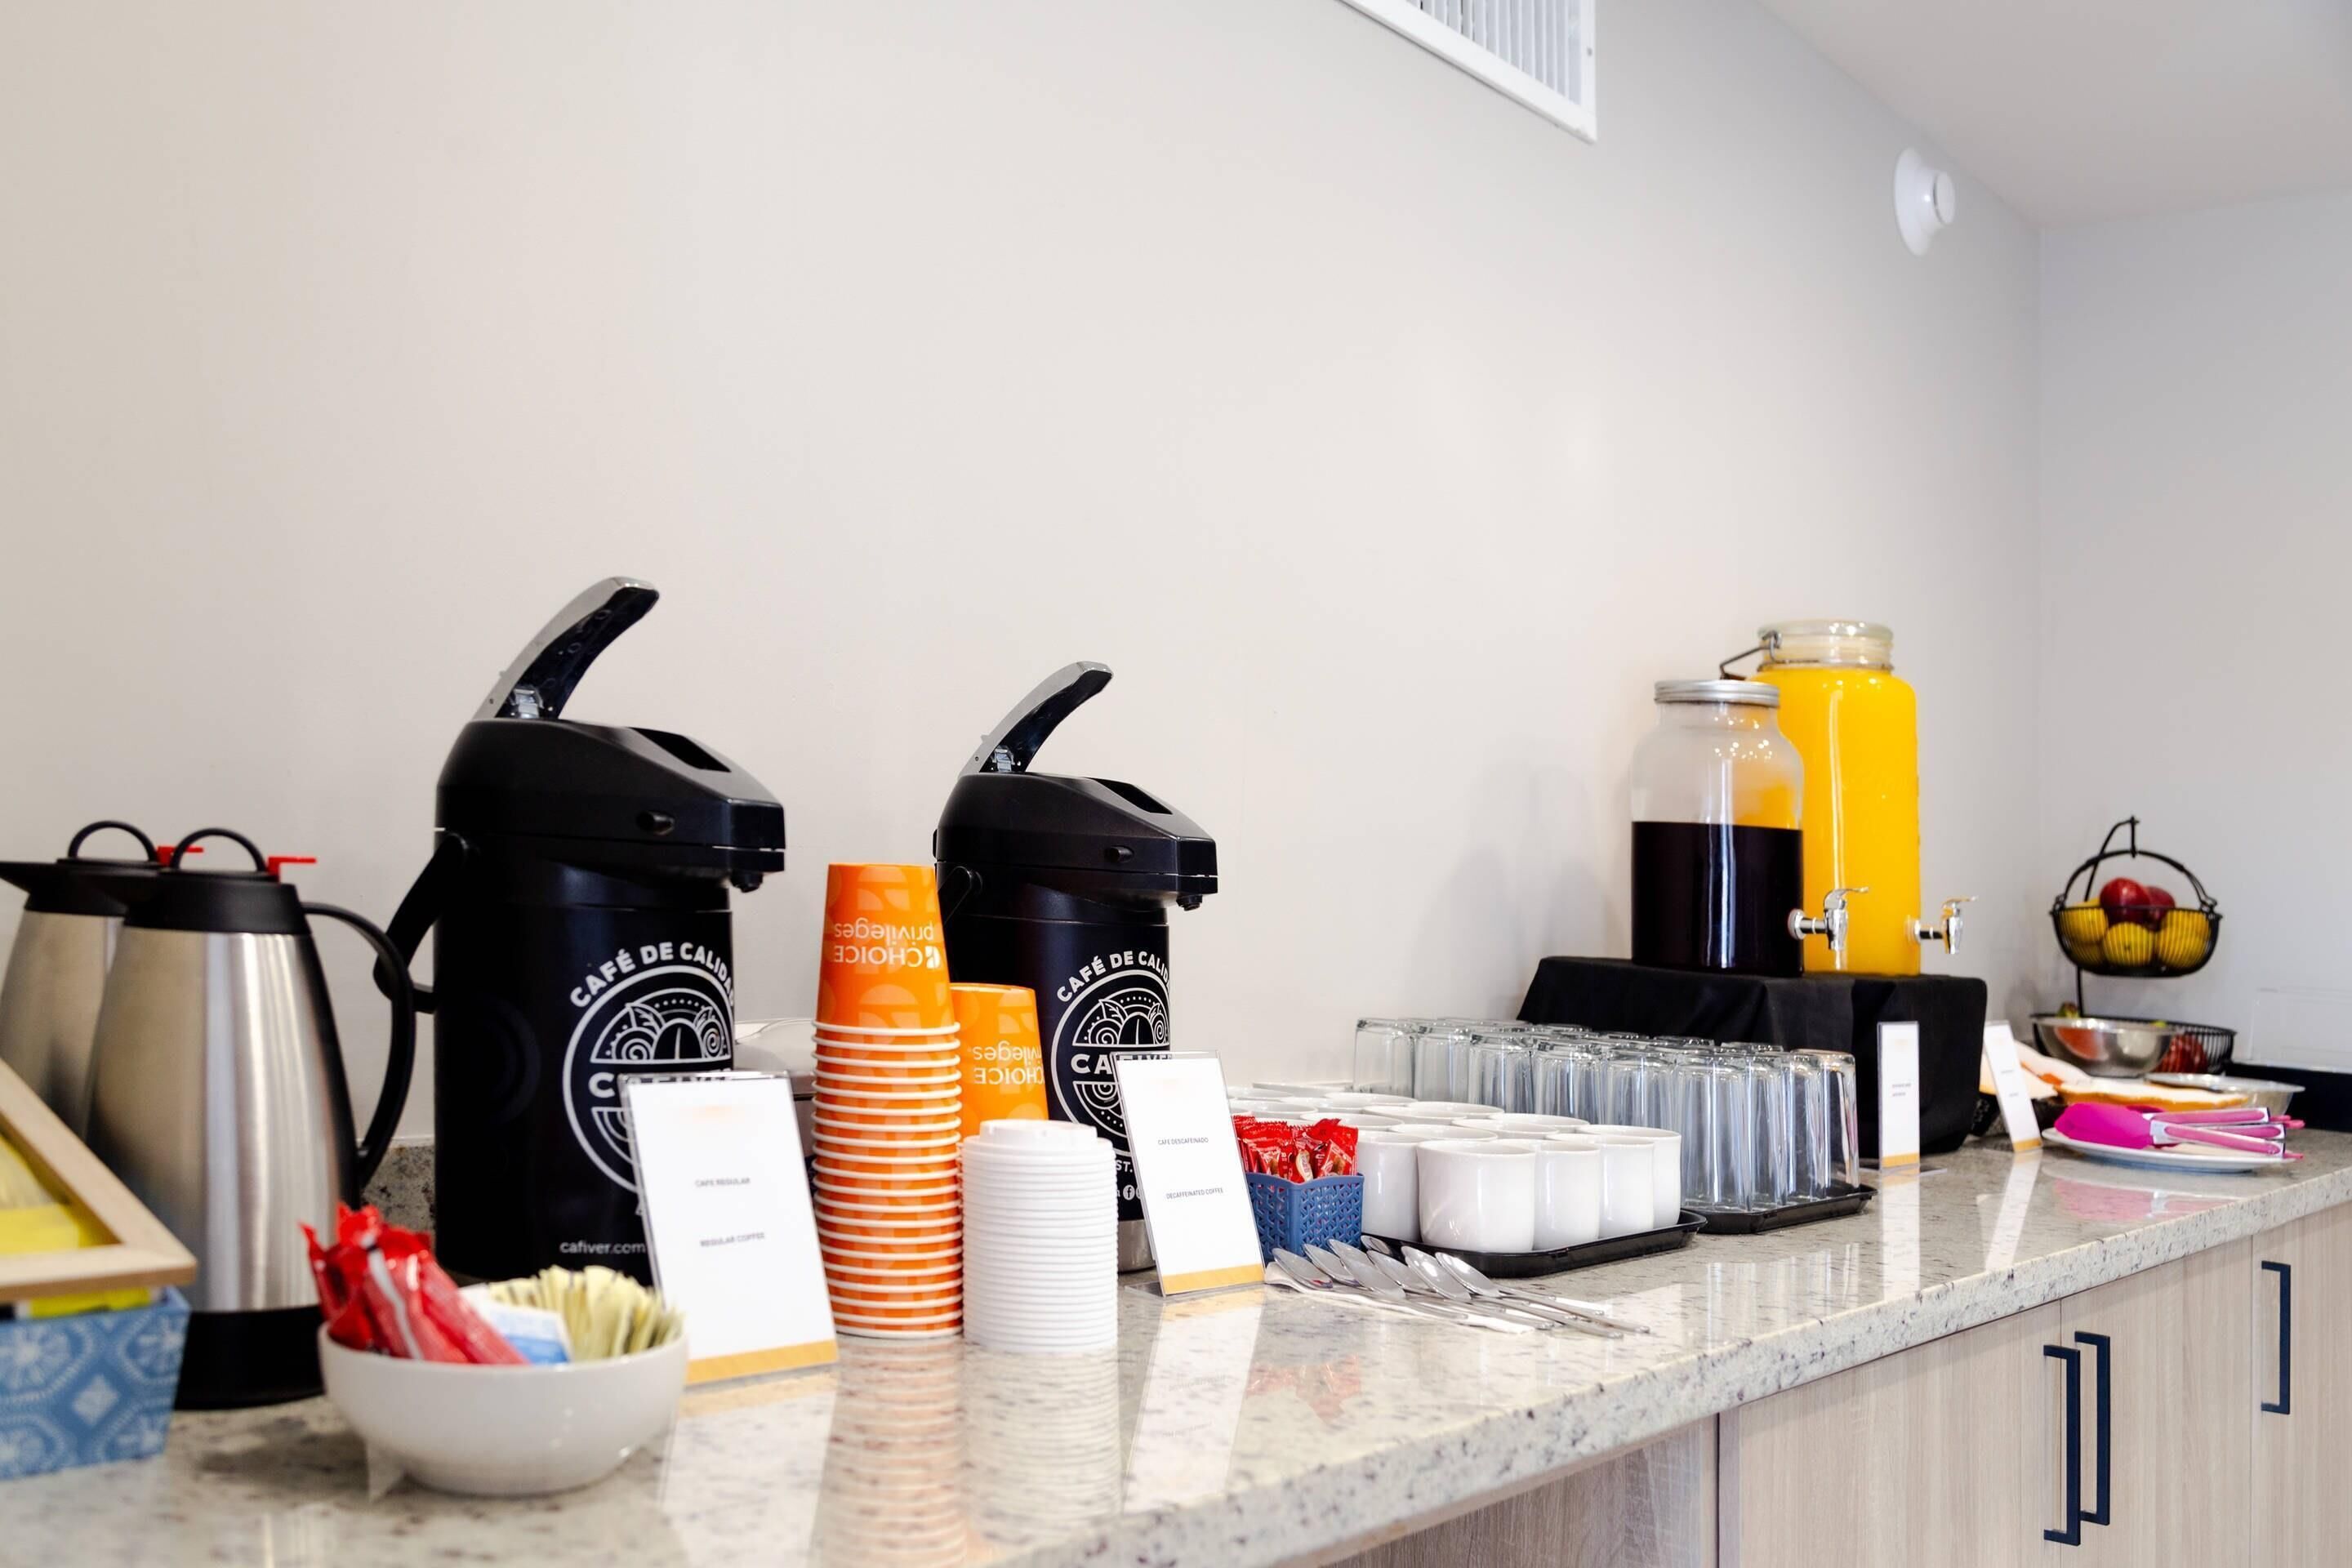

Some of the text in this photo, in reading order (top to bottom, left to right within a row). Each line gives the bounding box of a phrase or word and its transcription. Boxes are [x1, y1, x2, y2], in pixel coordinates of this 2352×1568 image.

[834, 917, 933, 946] privileges
[833, 944, 923, 968] CHOICE
[570, 948, 636, 1007] CAFÉ
[640, 942, 674, 964] DE
[1057, 956, 1107, 1002] CAFÉ
[1110, 951, 1134, 969] DE
[973, 1040, 1042, 1067] rivileges
[973, 1067, 1044, 1085] CHOICE
[716, 1177, 751, 1186] REGULAR
[1166, 1187, 1223, 1200] DECAFFEINATED COFFEE
[559, 1239, 646, 1254] cafiver.com
[700, 1232, 765, 1247] REGULAR COFFEE
